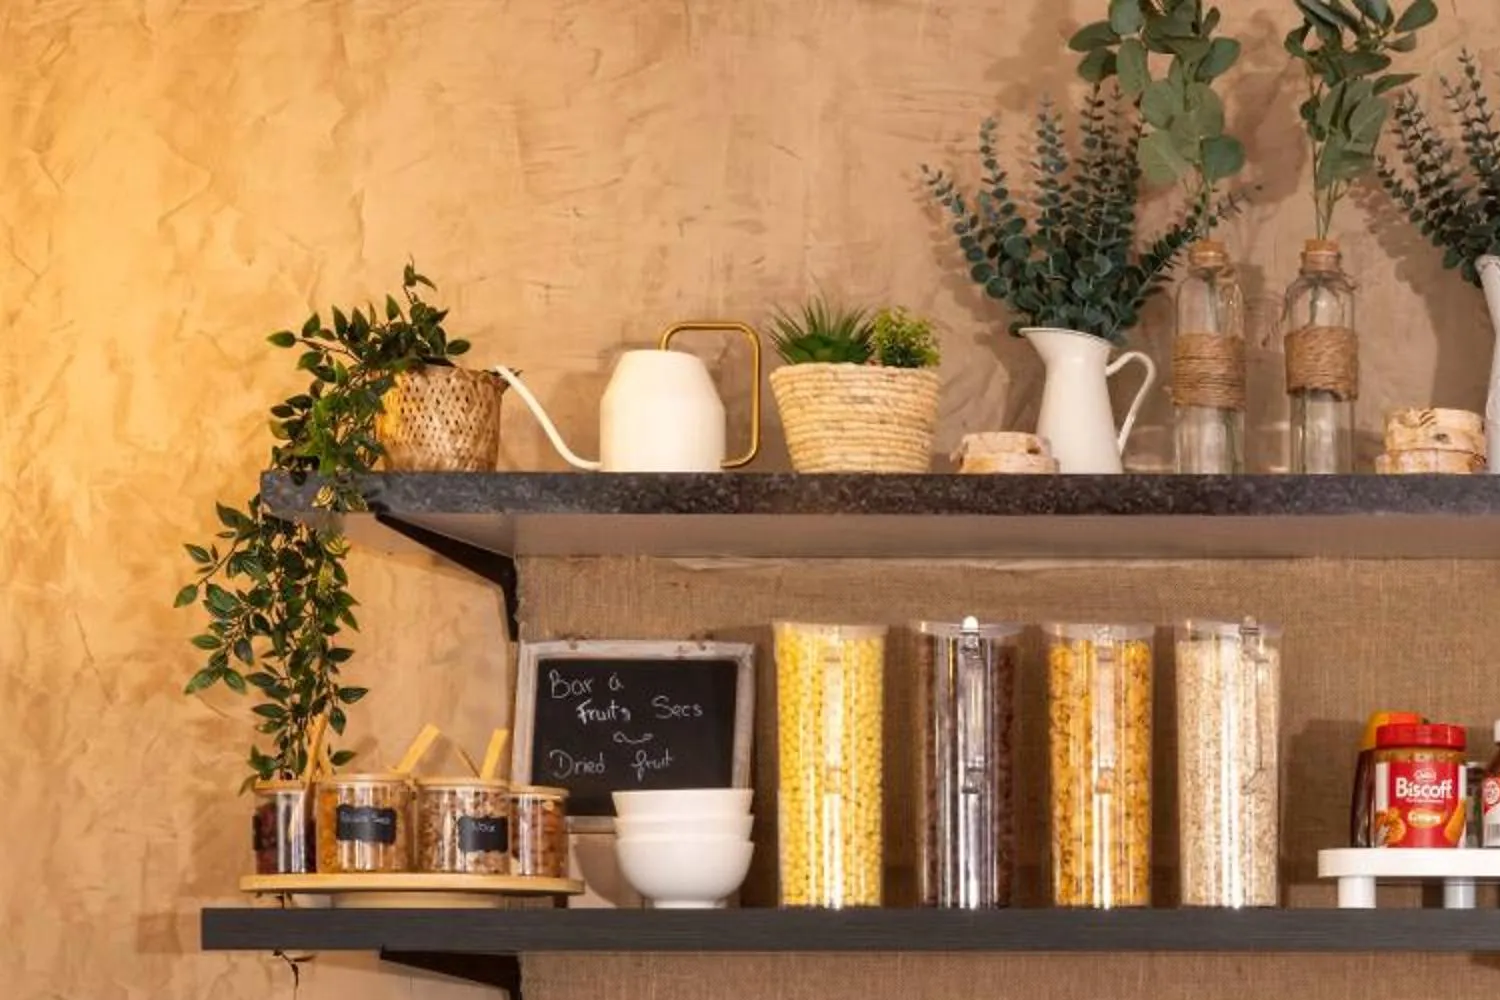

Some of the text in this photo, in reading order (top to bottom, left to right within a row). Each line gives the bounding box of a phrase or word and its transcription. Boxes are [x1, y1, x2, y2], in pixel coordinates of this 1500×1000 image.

[548, 669, 594, 699] Bar
[576, 695, 703, 724] Fruits Secs
[550, 750, 606, 779] Dried
[1395, 777, 1453, 799] Biscoff
